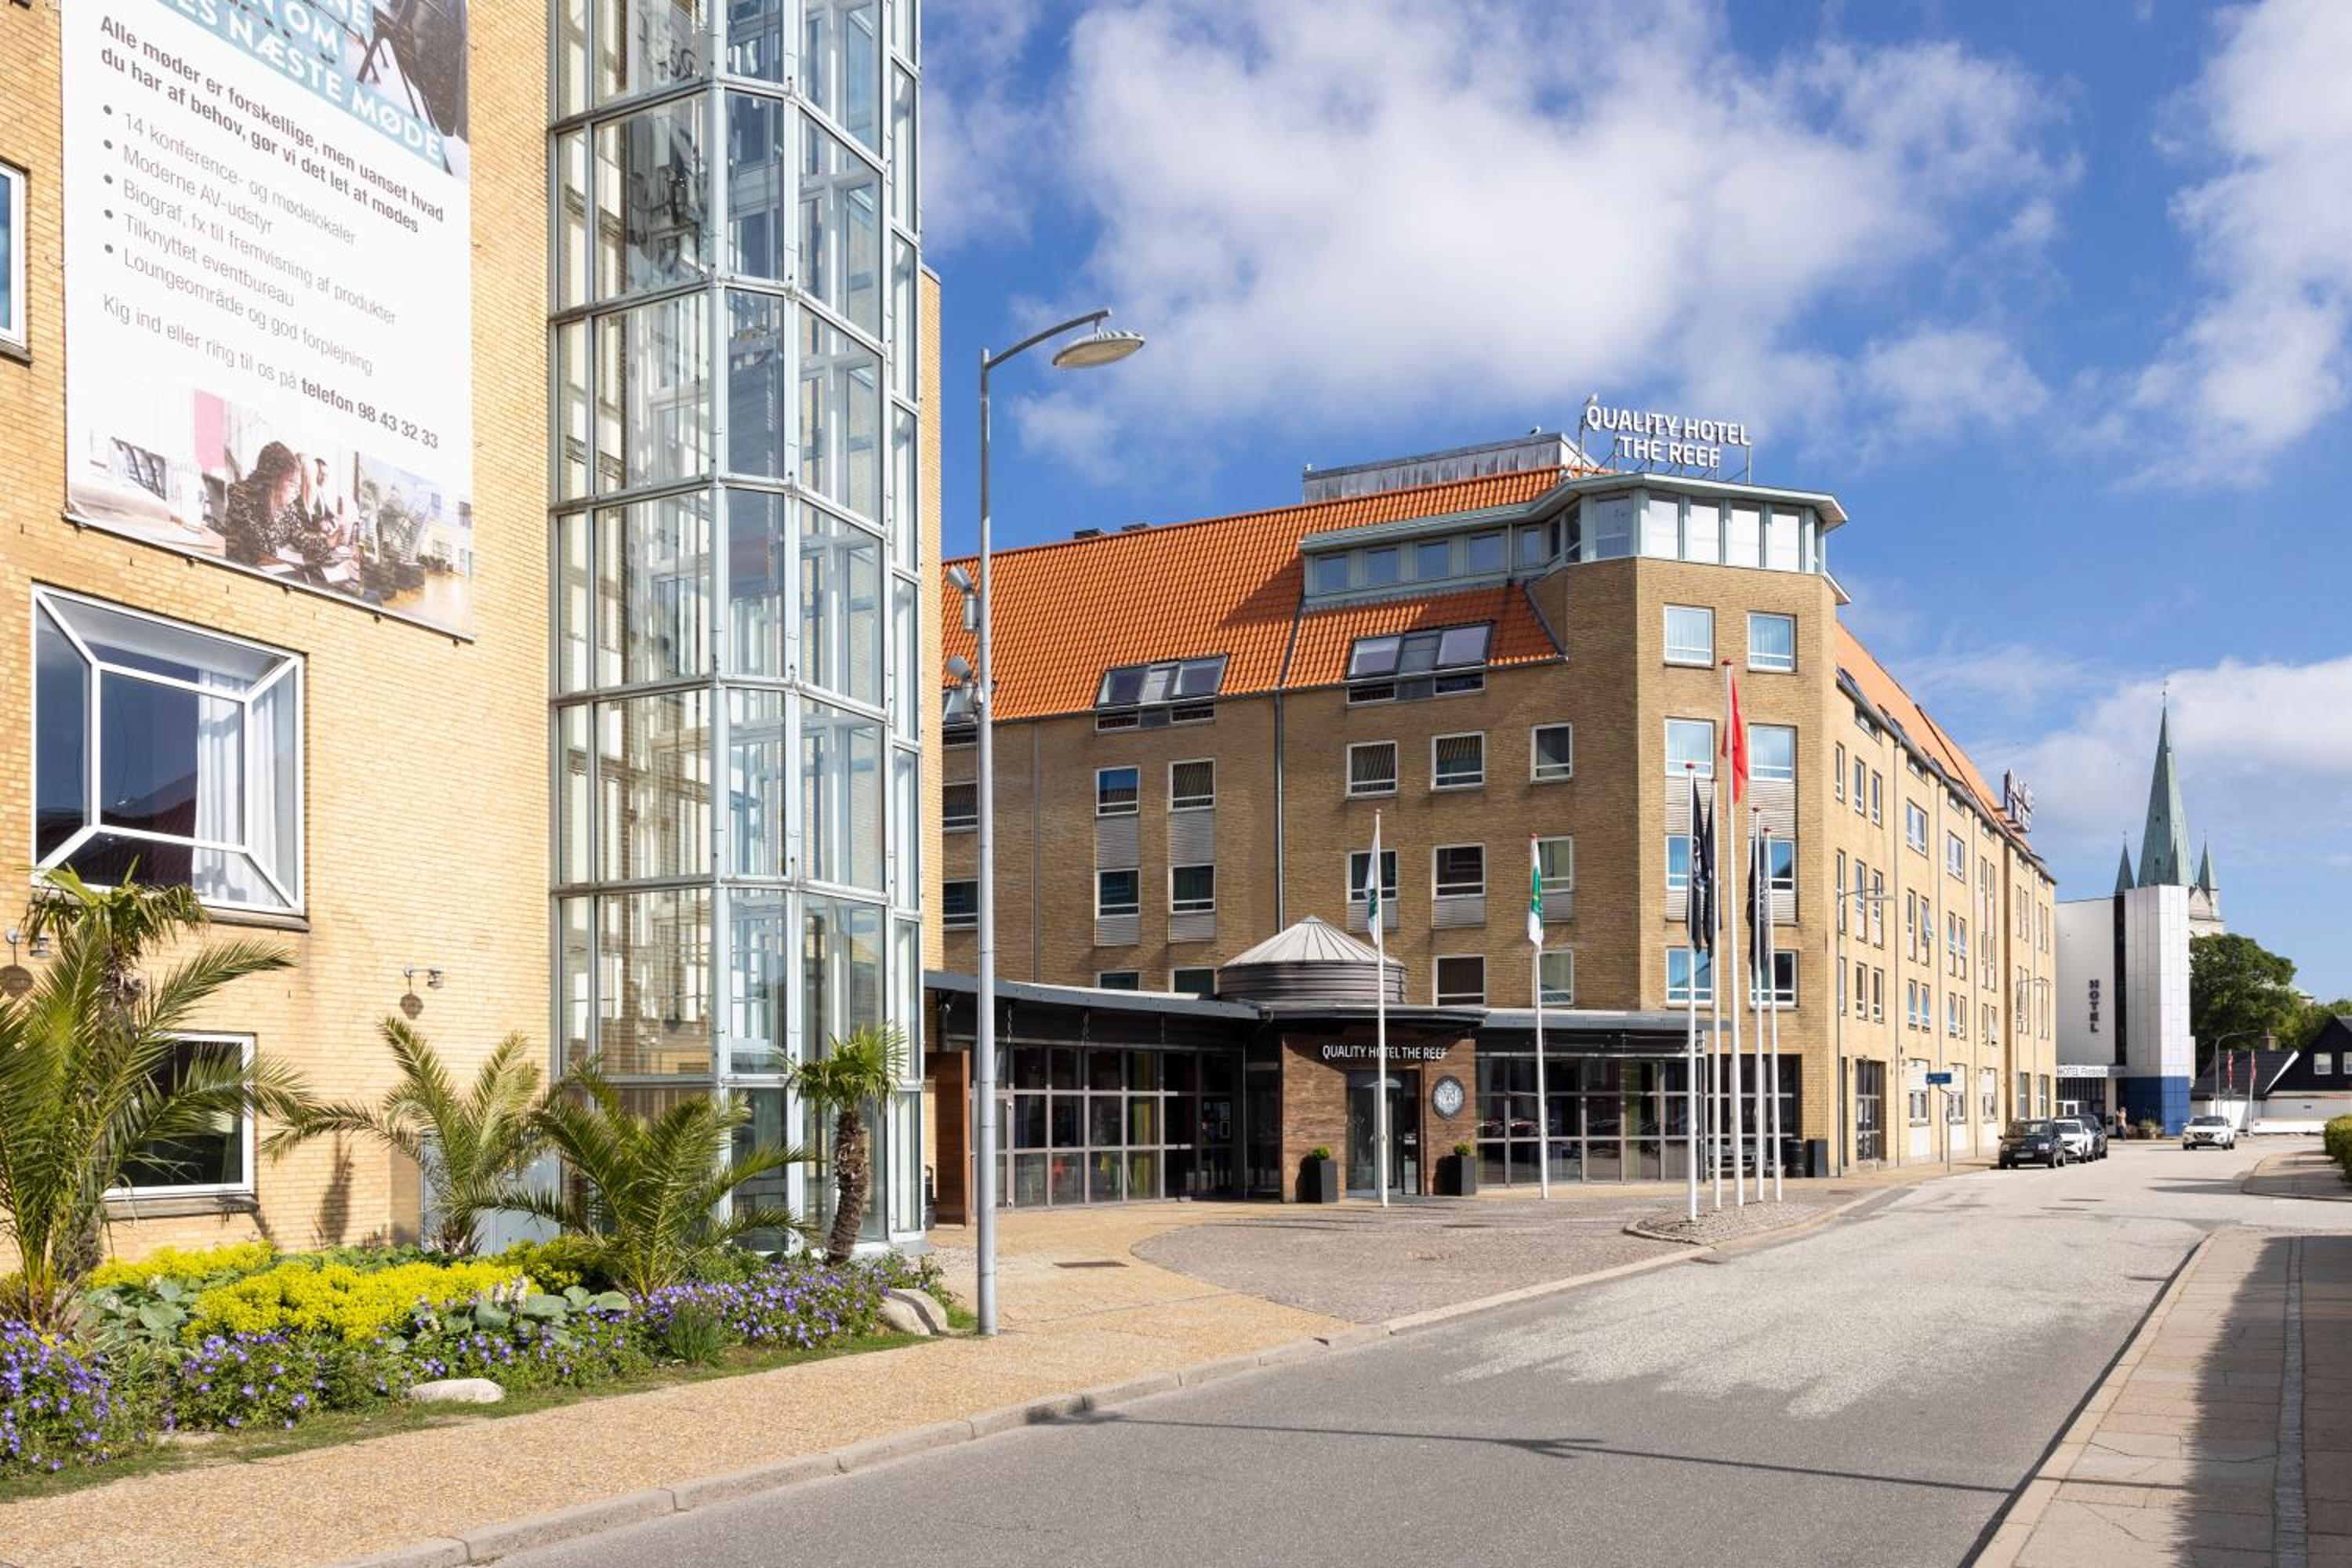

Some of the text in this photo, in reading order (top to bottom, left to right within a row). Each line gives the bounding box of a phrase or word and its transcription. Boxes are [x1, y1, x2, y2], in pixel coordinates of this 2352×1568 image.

[100, 15, 444, 222] Alle møder er forskellige, men uanset hvad
[101, 48, 419, 233] du har af behov, gør vi det let at mødes
[229, 9, 342, 102] NÆSTE
[352, 85, 441, 161] MØDE
[124, 144, 273, 235] Moderne AV-udstyr
[125, 112, 356, 246] 14 konference- og mødelokaler
[124, 179, 395, 328] Biograf, fx til fremvisning af produkter
[124, 212, 295, 307] Tilknyttet eventbureau
[125, 247, 373, 377] Loungeområde og god forplejning
[103, 293, 439, 449] Kig ind eller ring til os på telefon 98 43 32 33
[1585, 405, 1751, 446] QUALITY HOTEL
[1619, 435, 1720, 468] THE REEF
[1323, 1045, 1367, 1059] QUALITY
[1402, 1047, 1421, 1059] THE
[1423, 1047, 1448, 1059] REEF
[2089, 979, 2100, 1033] HOTEL
